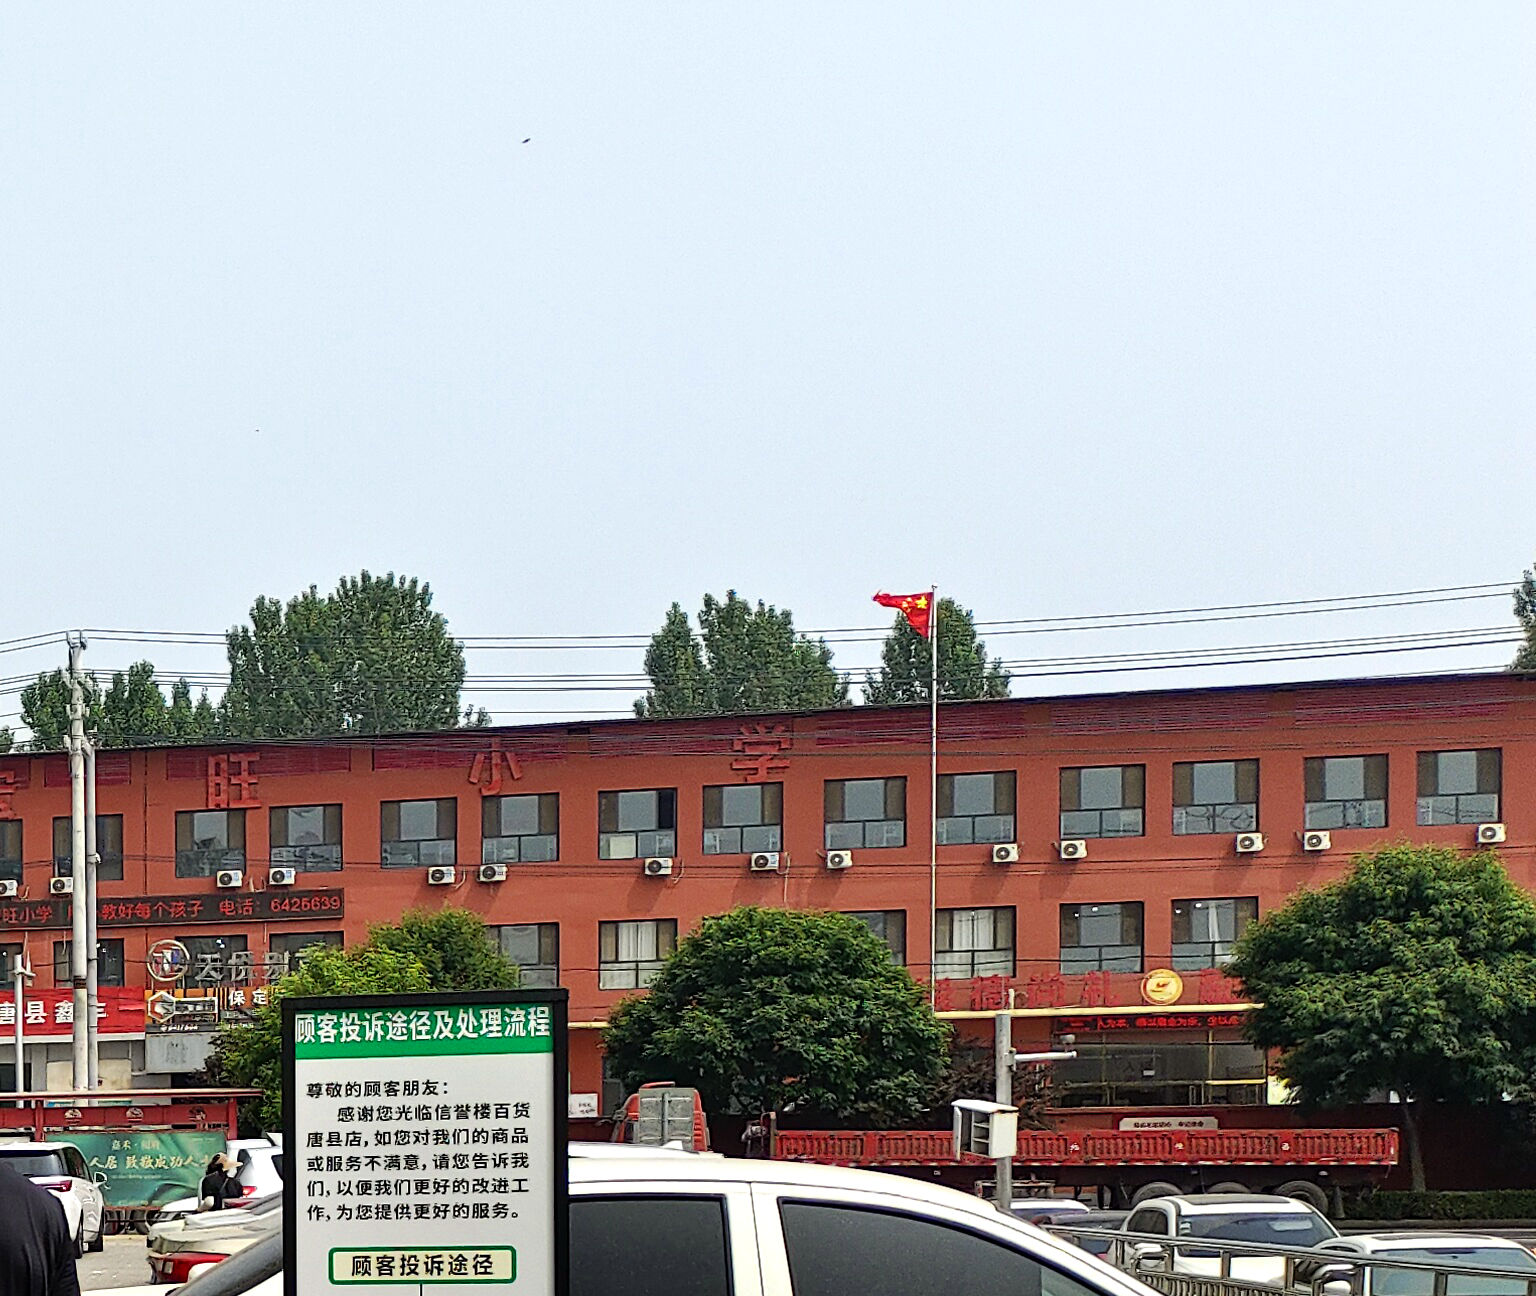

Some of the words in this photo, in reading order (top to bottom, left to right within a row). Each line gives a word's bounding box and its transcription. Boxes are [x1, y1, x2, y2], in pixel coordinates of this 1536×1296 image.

[294, 1005, 552, 1044] 顾客投诉途径及处理流程
[305, 1079, 450, 1100] 尊敬的顾客朋友：
[336, 1101, 531, 1123] 感谢您光临信誉楼百货
[305, 1127, 530, 1149] 唐县店，如您对我们的商品
[305, 1151, 530, 1173] 或服务不满意，请您告诉我
[306, 1177, 531, 1198] 们，以便我们更好的改进工
[306, 1201, 520, 1222] 作，为您提供更好的服务。
[350, 1253, 495, 1278] 顾客投诉途径
